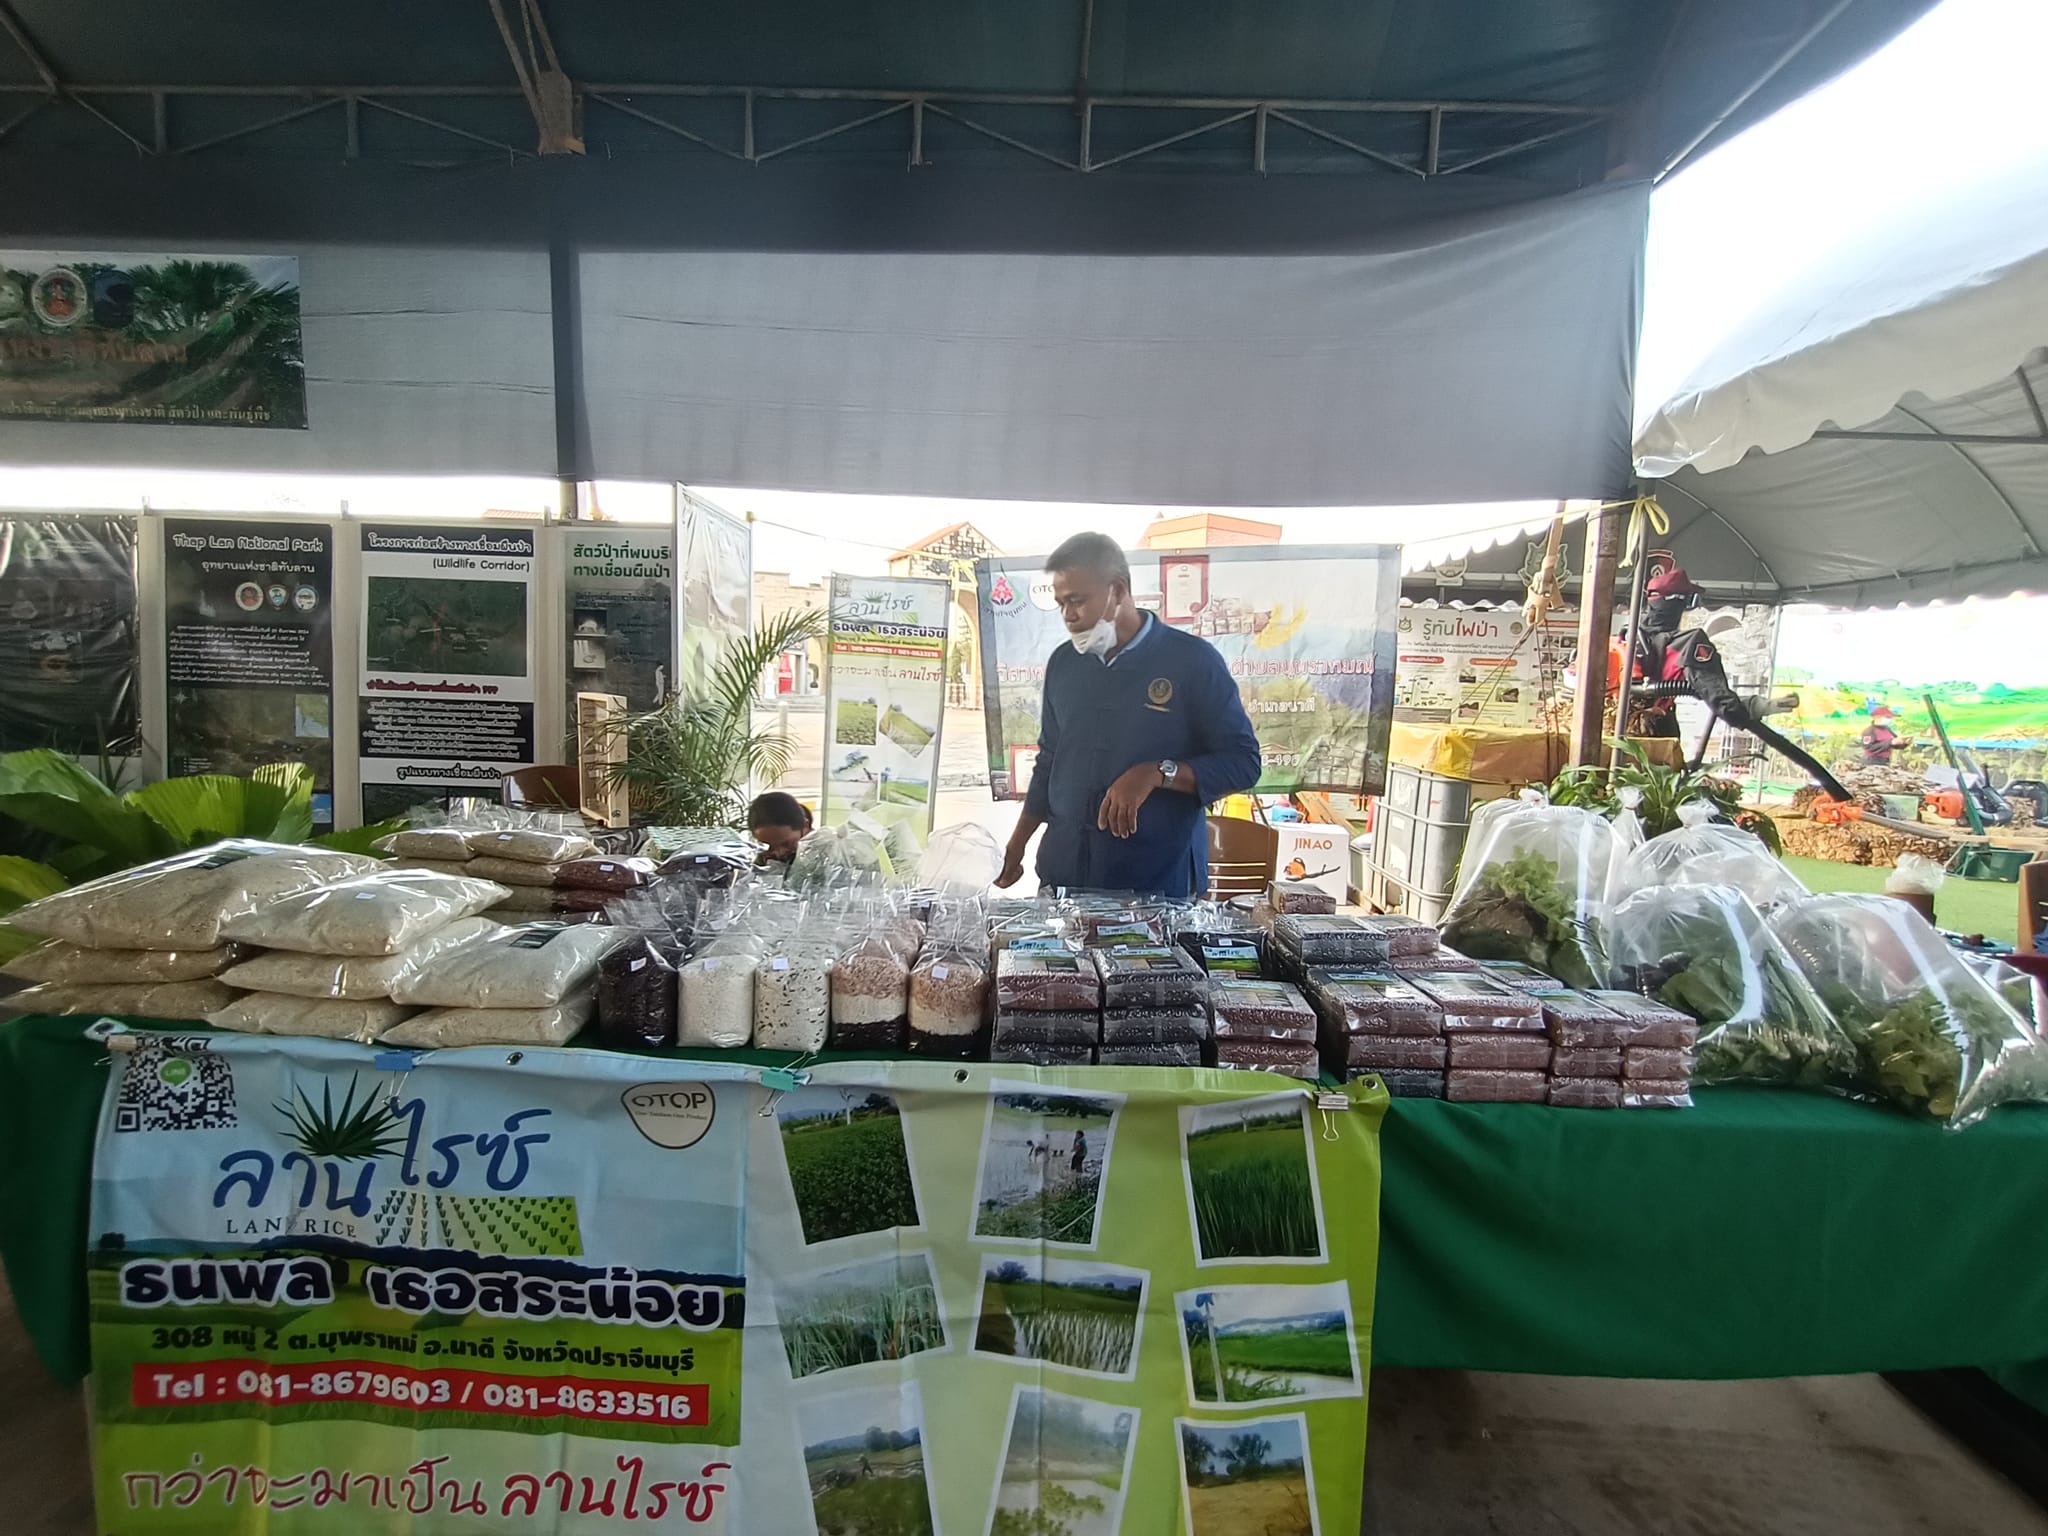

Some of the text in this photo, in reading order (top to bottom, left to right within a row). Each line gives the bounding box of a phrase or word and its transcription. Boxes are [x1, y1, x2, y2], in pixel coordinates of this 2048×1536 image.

[173, 533, 323, 552] Thap Lan National Park
[368, 531, 532, 553] โครงการก่อสร้างทางเชื่อมผืนป่า
[202, 560, 315, 573] อุทยานแห่งชาติทับลาน
[433, 557, 530, 572] (Wildlife Corridor)
[573, 558, 670, 578] ทางเชื่อมผืนป่า
[1423, 617, 1498, 640] รู้ทันไฟป่า
[397, 763, 501, 780] รูปแบบทางเชื่อมผืนป่า
[1293, 837, 1333, 852] JINAO
[632, 1092, 707, 1109] OTOP
[227, 1217, 357, 1238] LAN RICE
[122, 1256, 724, 1331] ธนพล เธอสระน้อย
[152, 1326, 213, 1349] 308
[223, 1325, 257, 1352] หมู่
[263, 1328, 279, 1351] 2
[423, 1336, 495, 1358] อ.นาดี
[503, 1339, 694, 1376] จังหวัดปราจีนบุรี
[153, 1373, 205, 1398] Tel
[237, 1370, 451, 1404] 081-8679603
[460, 1381, 474, 1404] /
[483, 1383, 691, 1419] 081-8633516
[501, 1454, 732, 1522] ลานไรซ์
